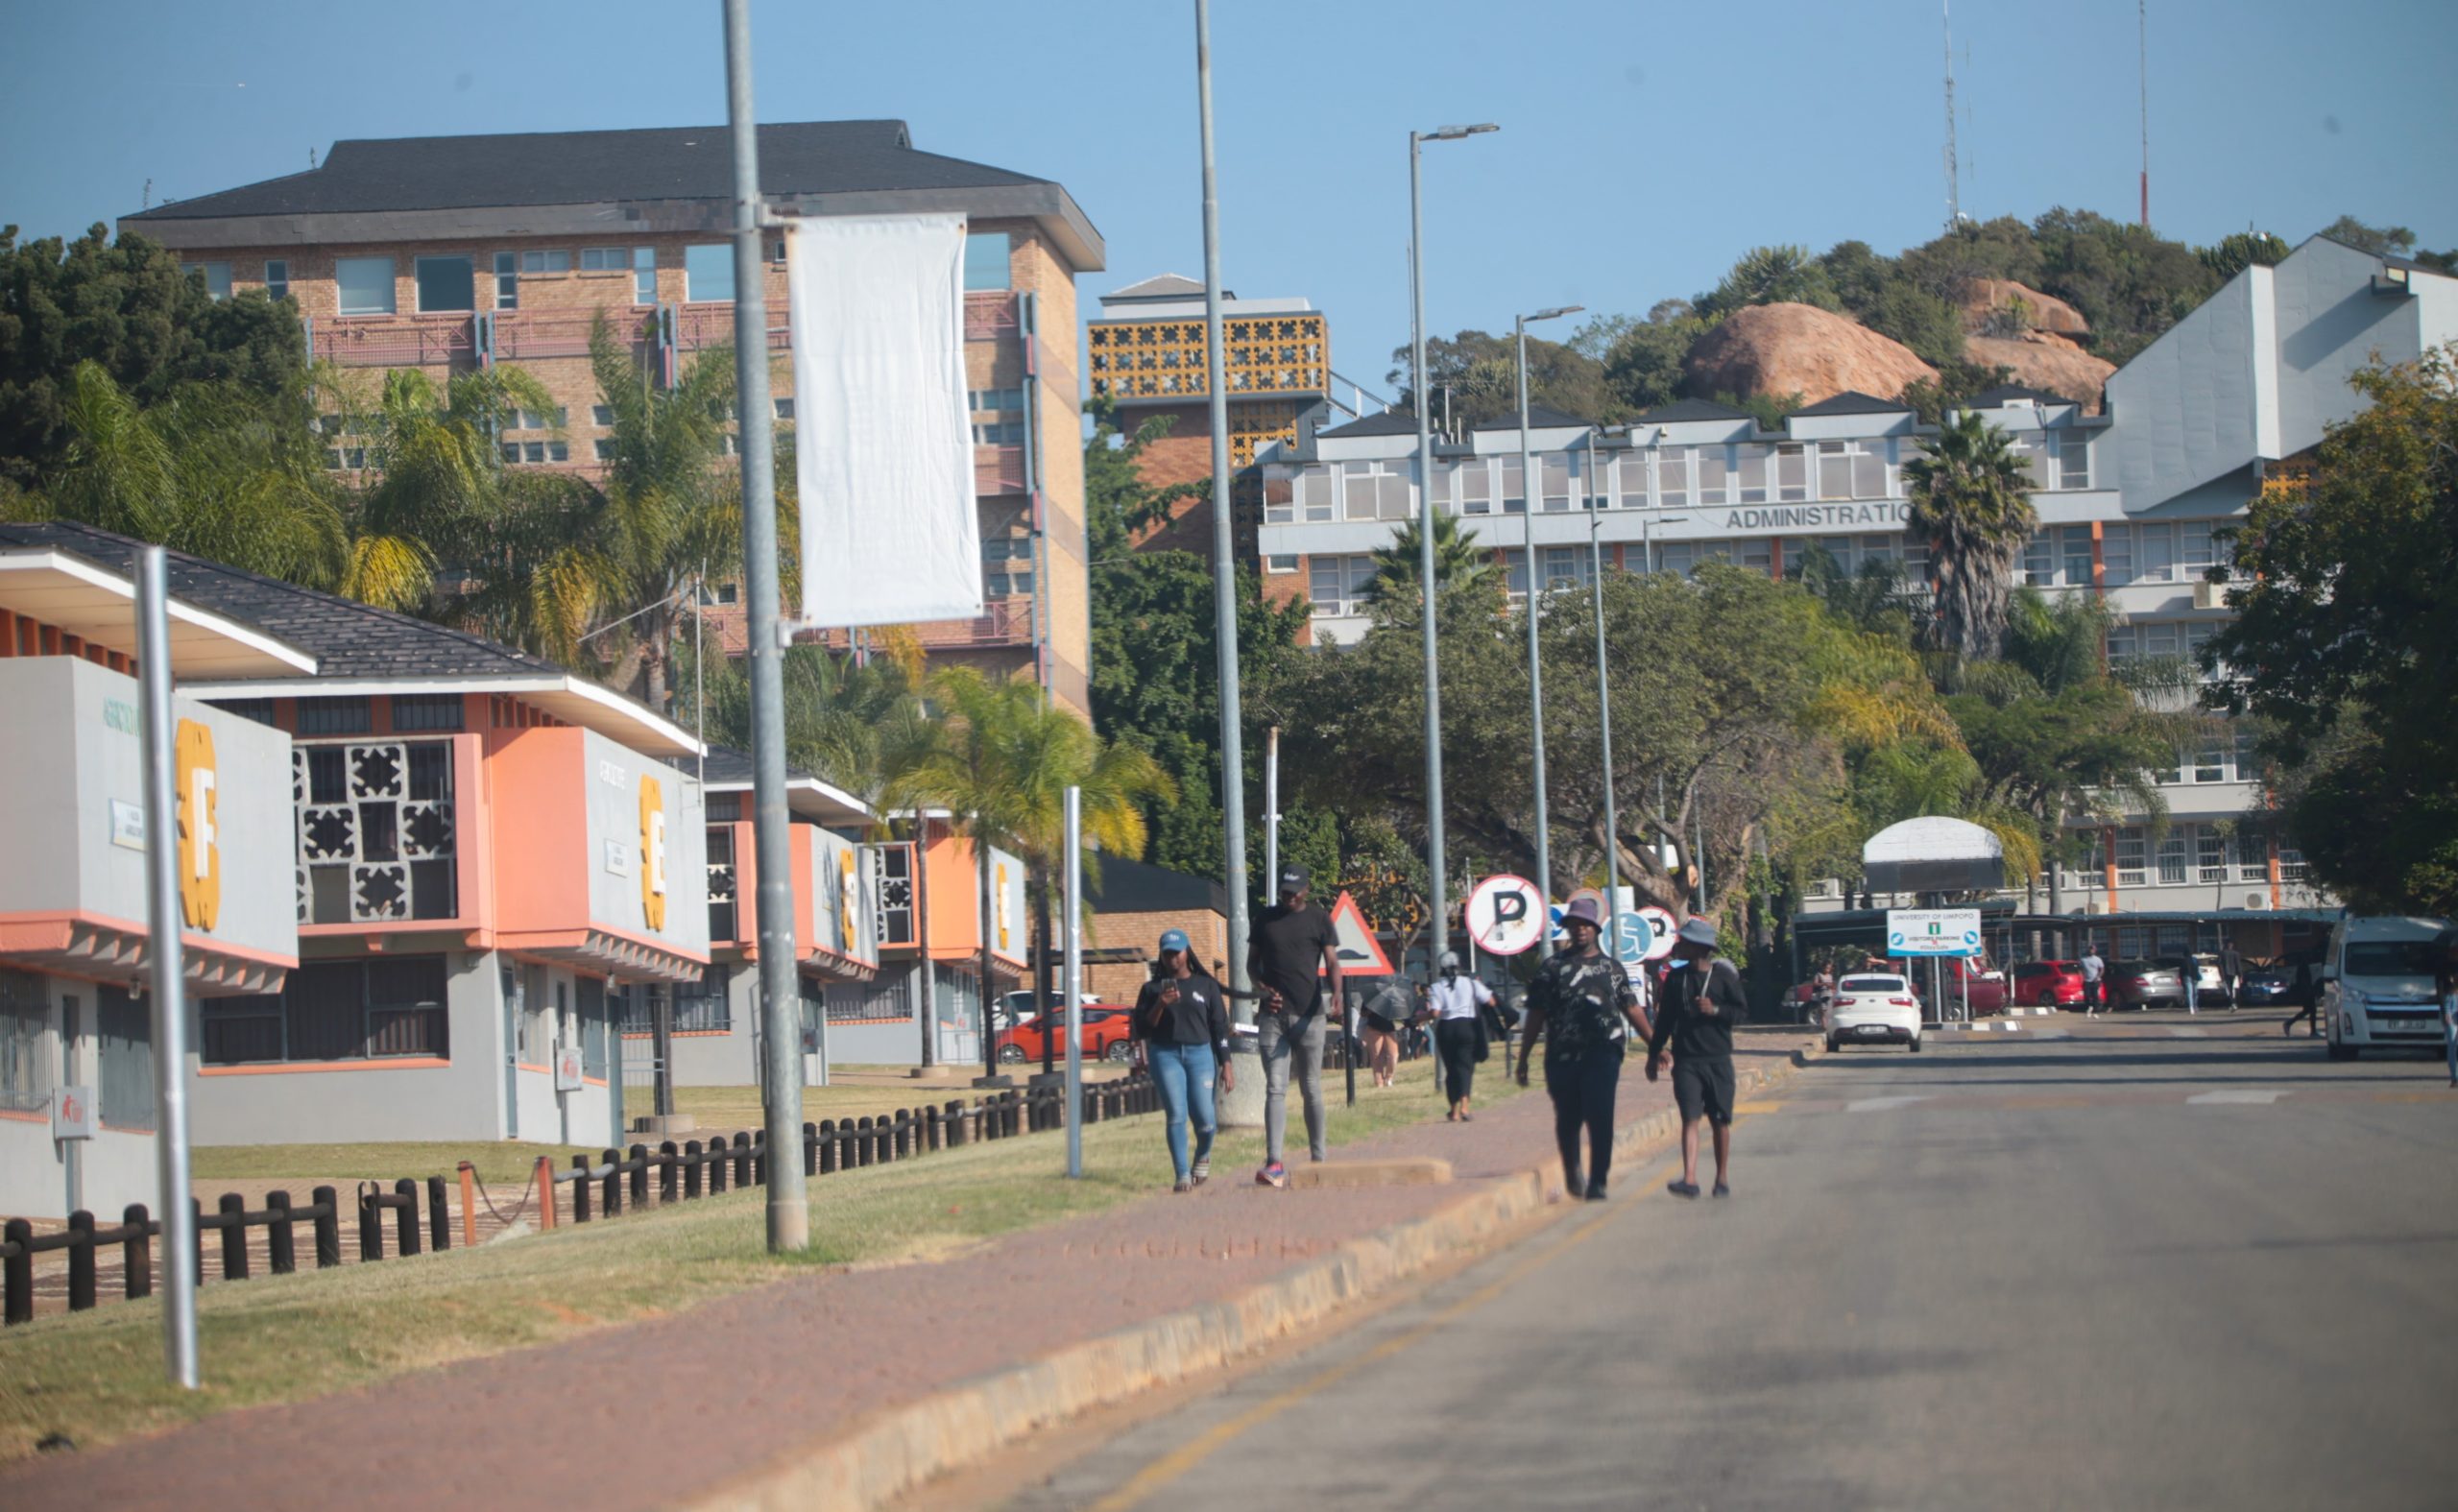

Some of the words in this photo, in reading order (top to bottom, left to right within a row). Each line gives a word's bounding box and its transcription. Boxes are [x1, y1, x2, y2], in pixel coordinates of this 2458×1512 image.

[1726, 502, 1912, 528] ADMINISTRATIO
[191, 767, 215, 877] F
[650, 810, 666, 894] E
[1492, 891, 1528, 941] P
